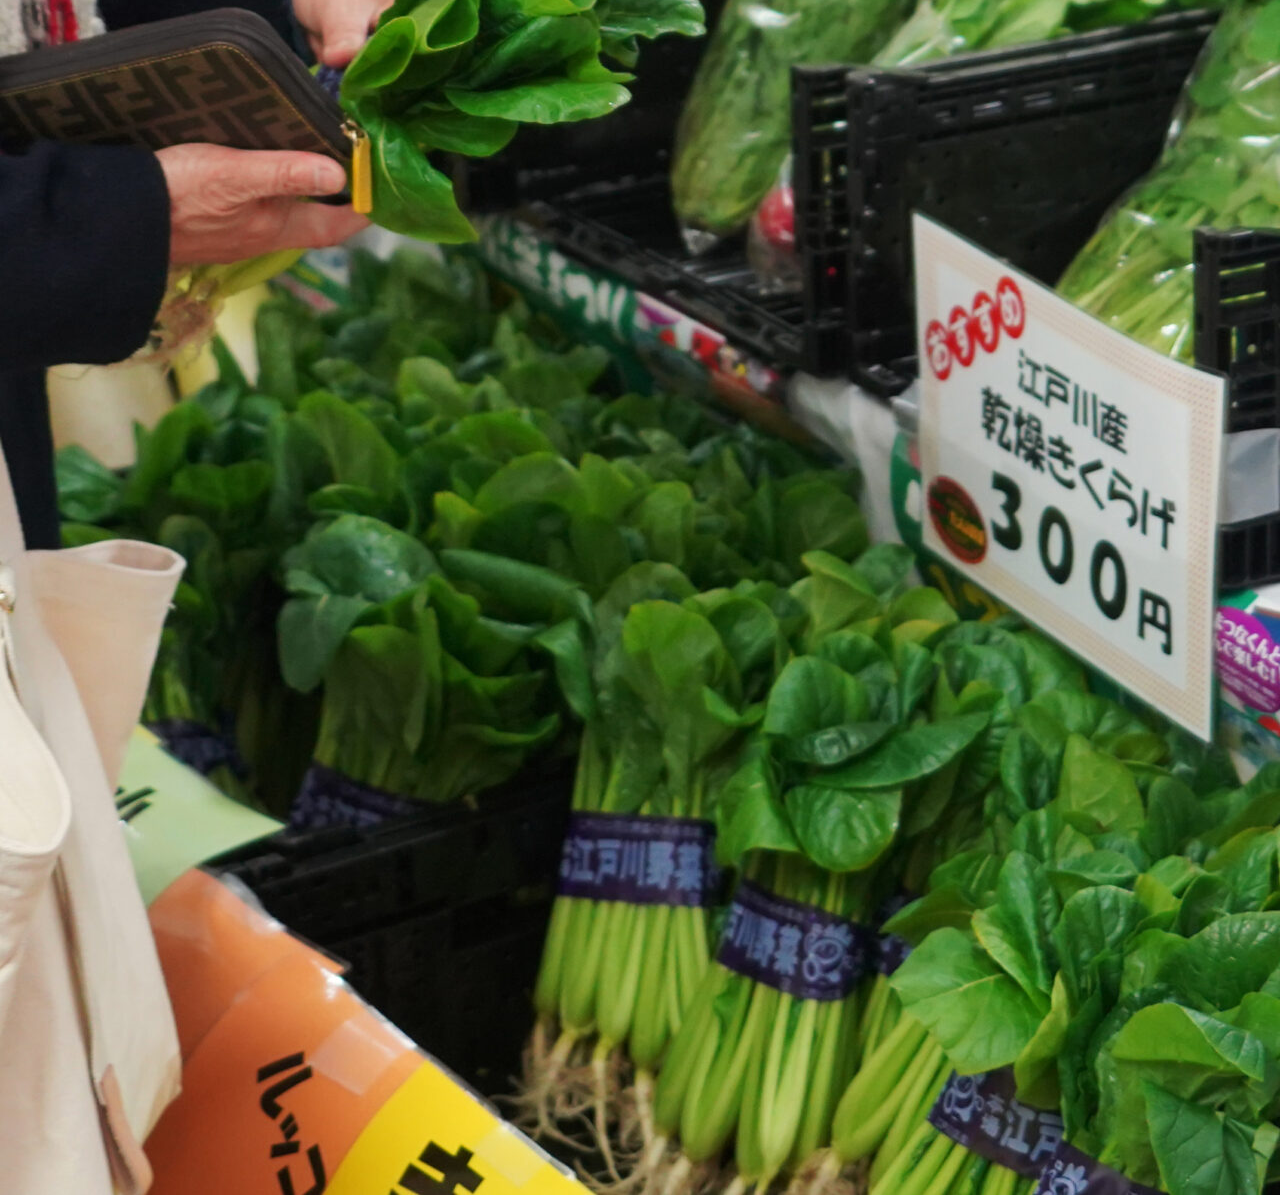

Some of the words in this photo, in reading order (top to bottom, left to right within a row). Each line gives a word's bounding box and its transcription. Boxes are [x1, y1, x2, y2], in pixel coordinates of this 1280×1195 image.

[926, 285, 1024, 373] おすすめ
[982, 386, 1177, 550] 乾燥きくらげ
[1018, 348, 1128, 455] 江戸川産
[990, 470, 1173, 656] 300円
